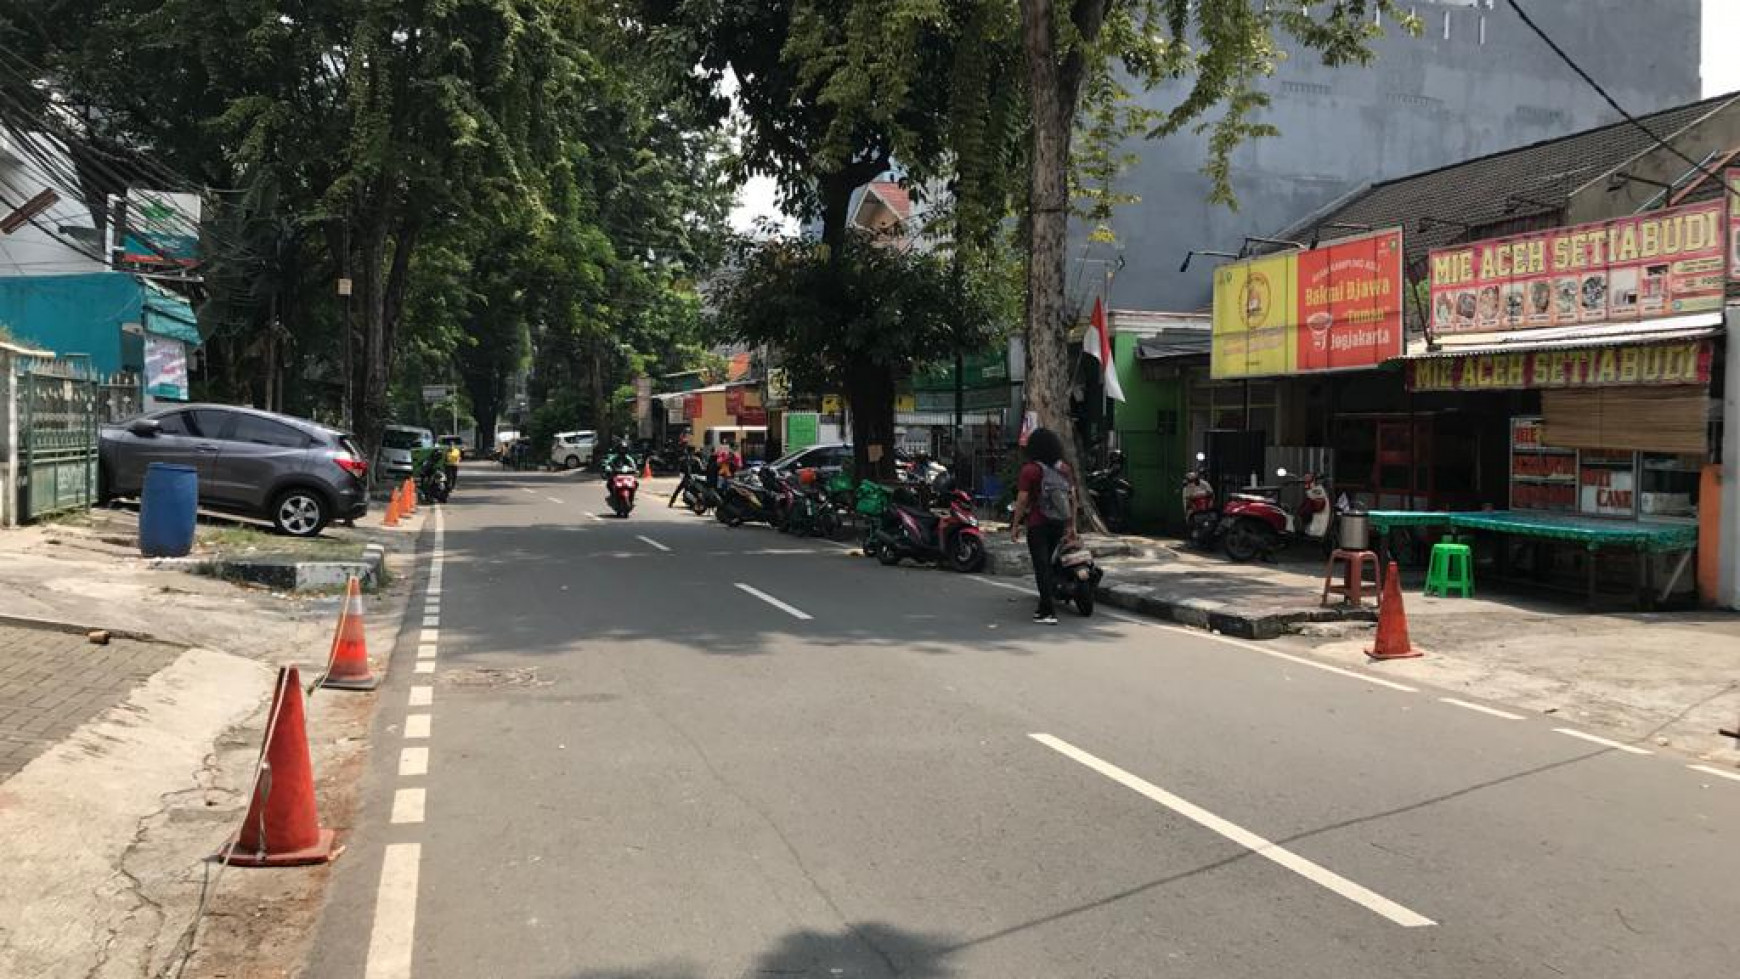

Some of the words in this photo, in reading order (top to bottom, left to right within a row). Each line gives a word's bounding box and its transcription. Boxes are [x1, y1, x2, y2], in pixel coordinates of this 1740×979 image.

[1435, 251, 1473, 285] MIE
[1481, 241, 1546, 280] ACEH
[1554, 211, 1719, 268] SETIABUDI
[1305, 281, 1344, 306] Bakmi
[1416, 357, 1452, 388] MIE
[1463, 352, 1523, 386] ACEH
[1534, 346, 1698, 383] SETIABUDI
